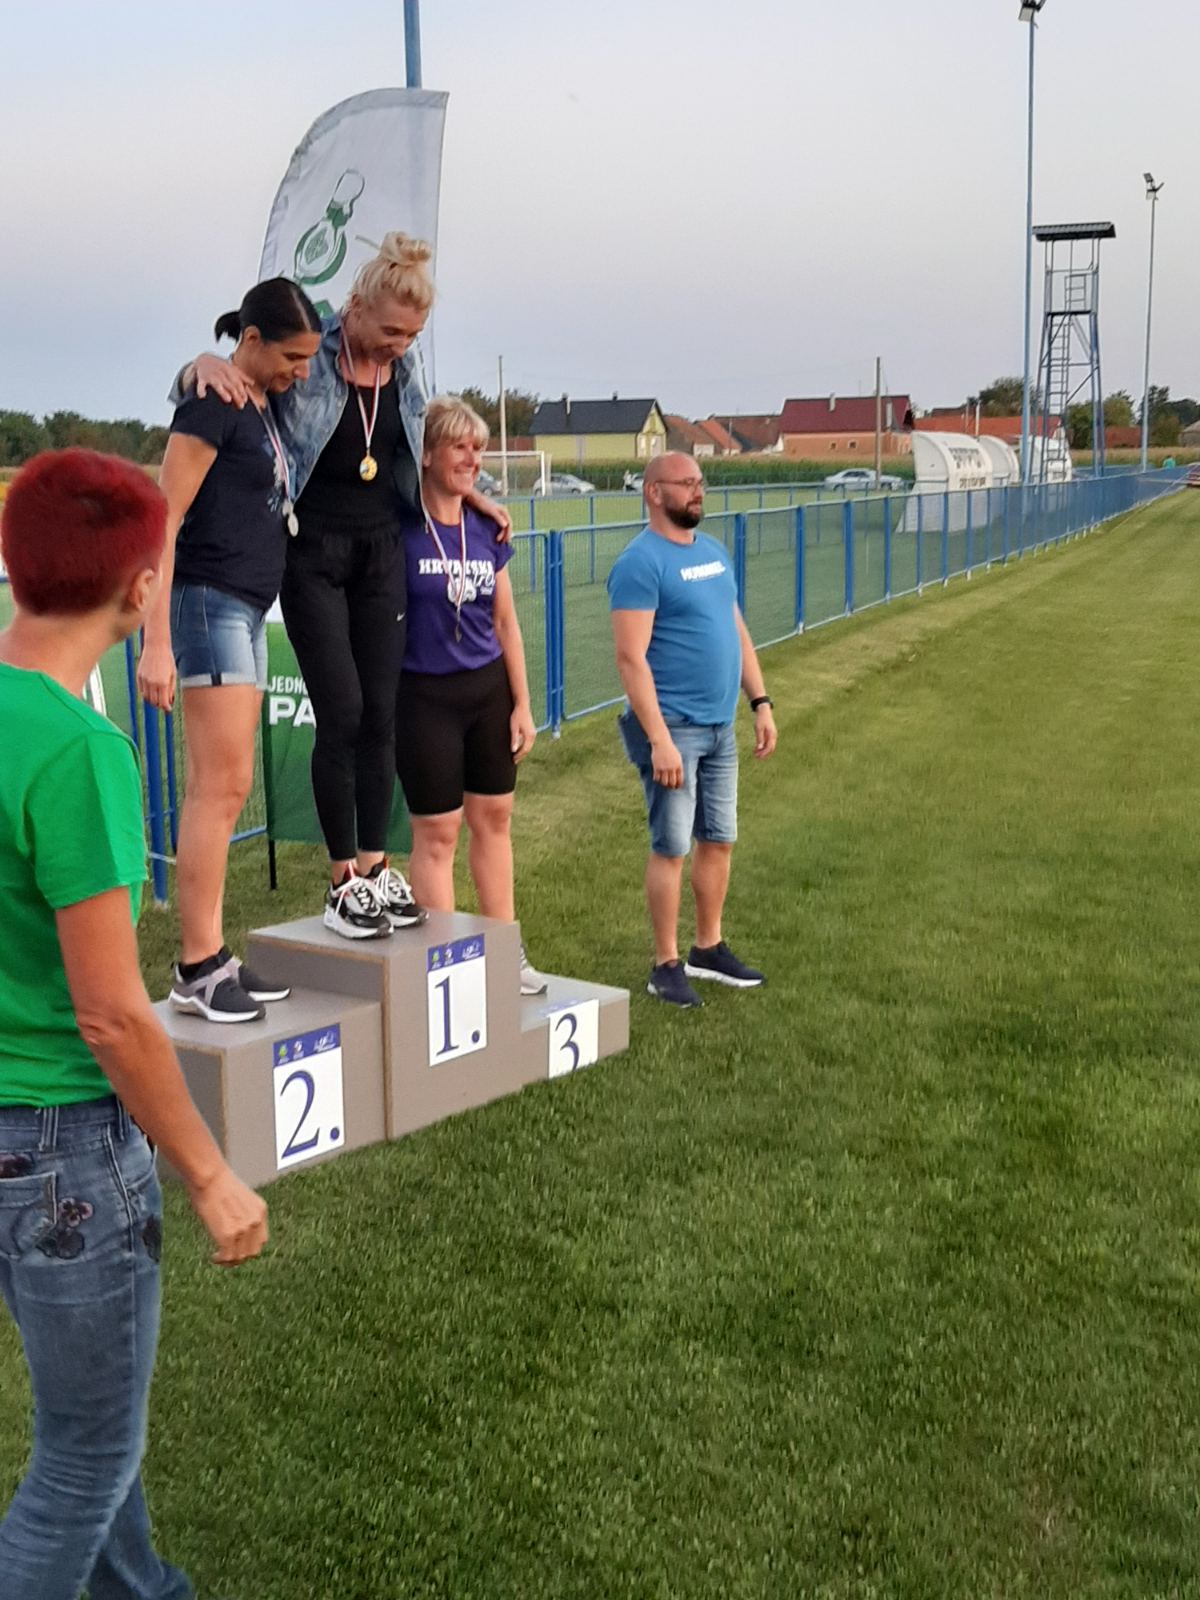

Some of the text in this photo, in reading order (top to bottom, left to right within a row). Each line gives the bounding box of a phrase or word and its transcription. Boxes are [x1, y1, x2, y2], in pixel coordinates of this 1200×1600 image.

[269, 695, 317, 728] PA
[435, 976, 480, 1056] 1.
[280, 1070, 340, 1159] 2.
